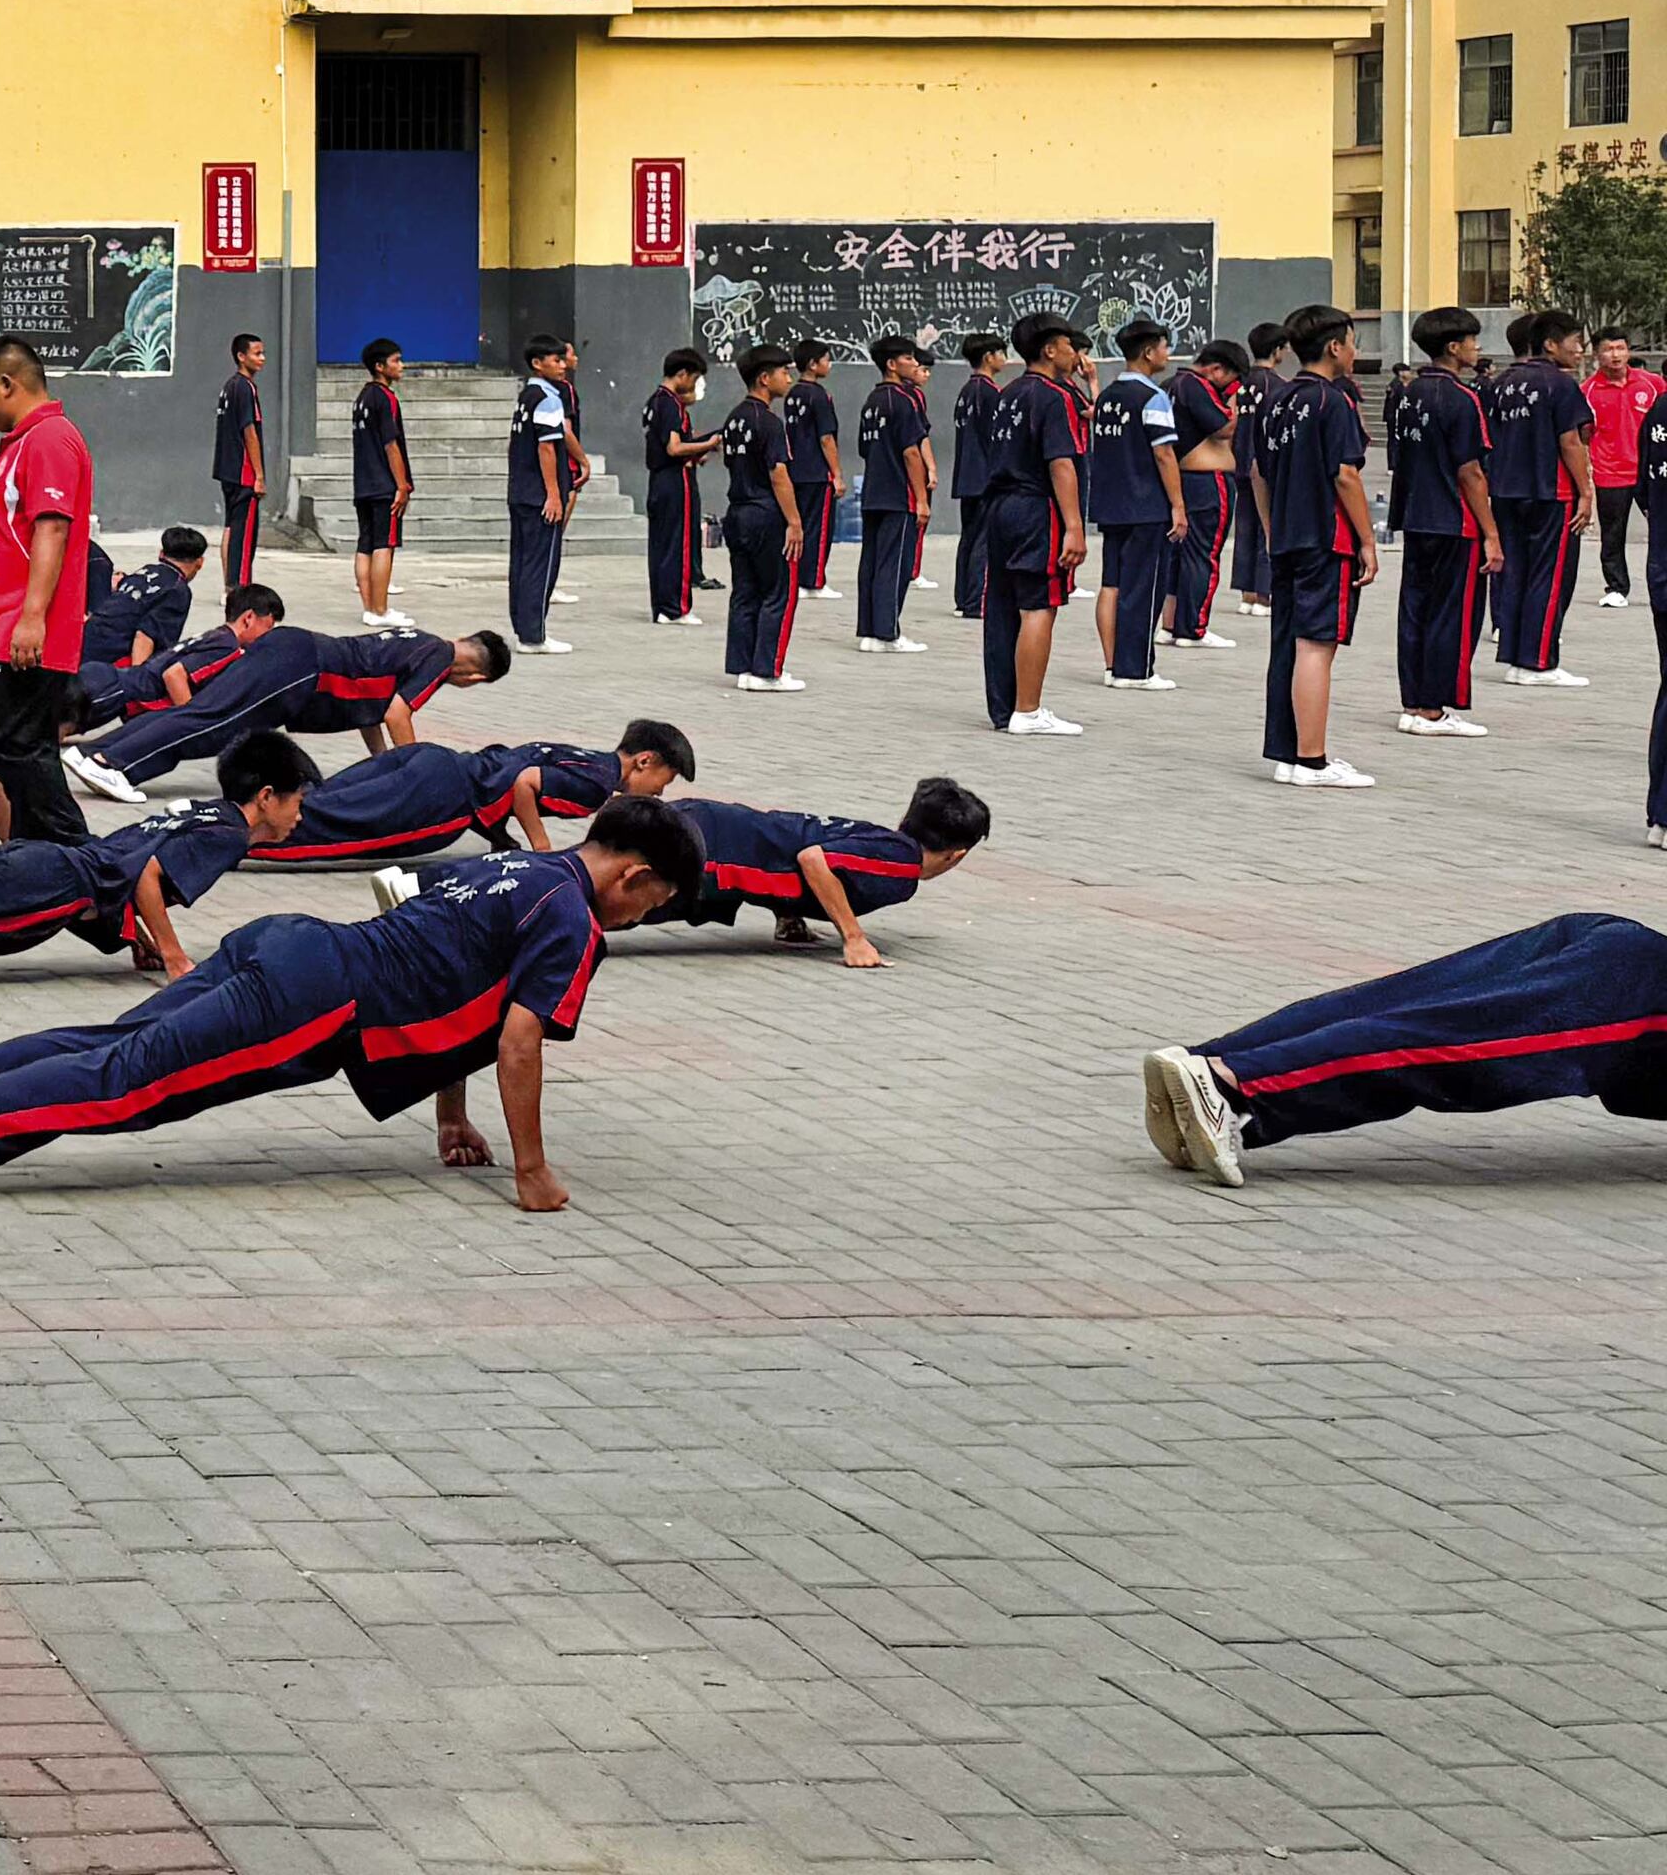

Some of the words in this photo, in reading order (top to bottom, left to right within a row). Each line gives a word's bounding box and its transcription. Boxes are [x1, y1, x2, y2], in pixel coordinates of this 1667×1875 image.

[834, 227, 1075, 273] 安全伴我行
